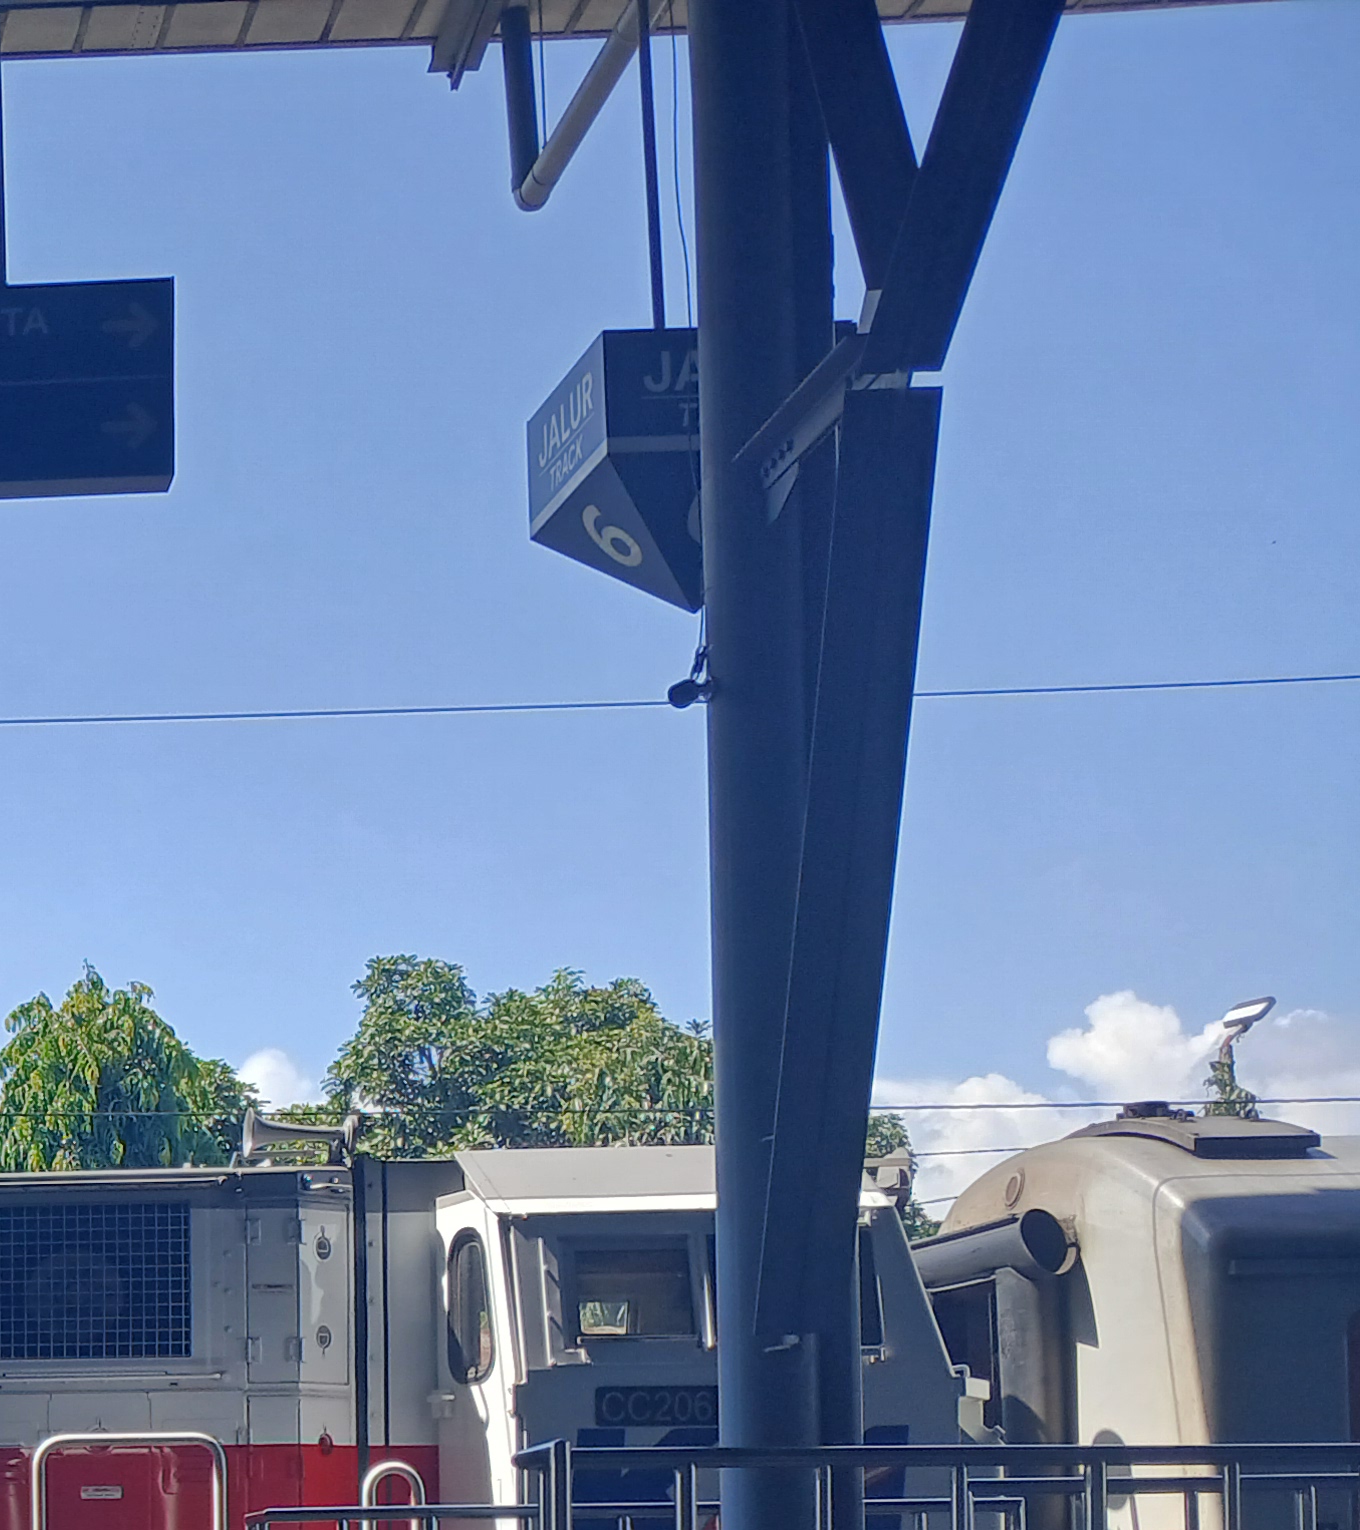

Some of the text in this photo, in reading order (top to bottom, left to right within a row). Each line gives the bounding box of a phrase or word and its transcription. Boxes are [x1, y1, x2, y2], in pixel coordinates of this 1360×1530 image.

[538, 371, 593, 468] JALUR
[548, 434, 583, 491] TRACK
[582, 504, 643, 567] 6
